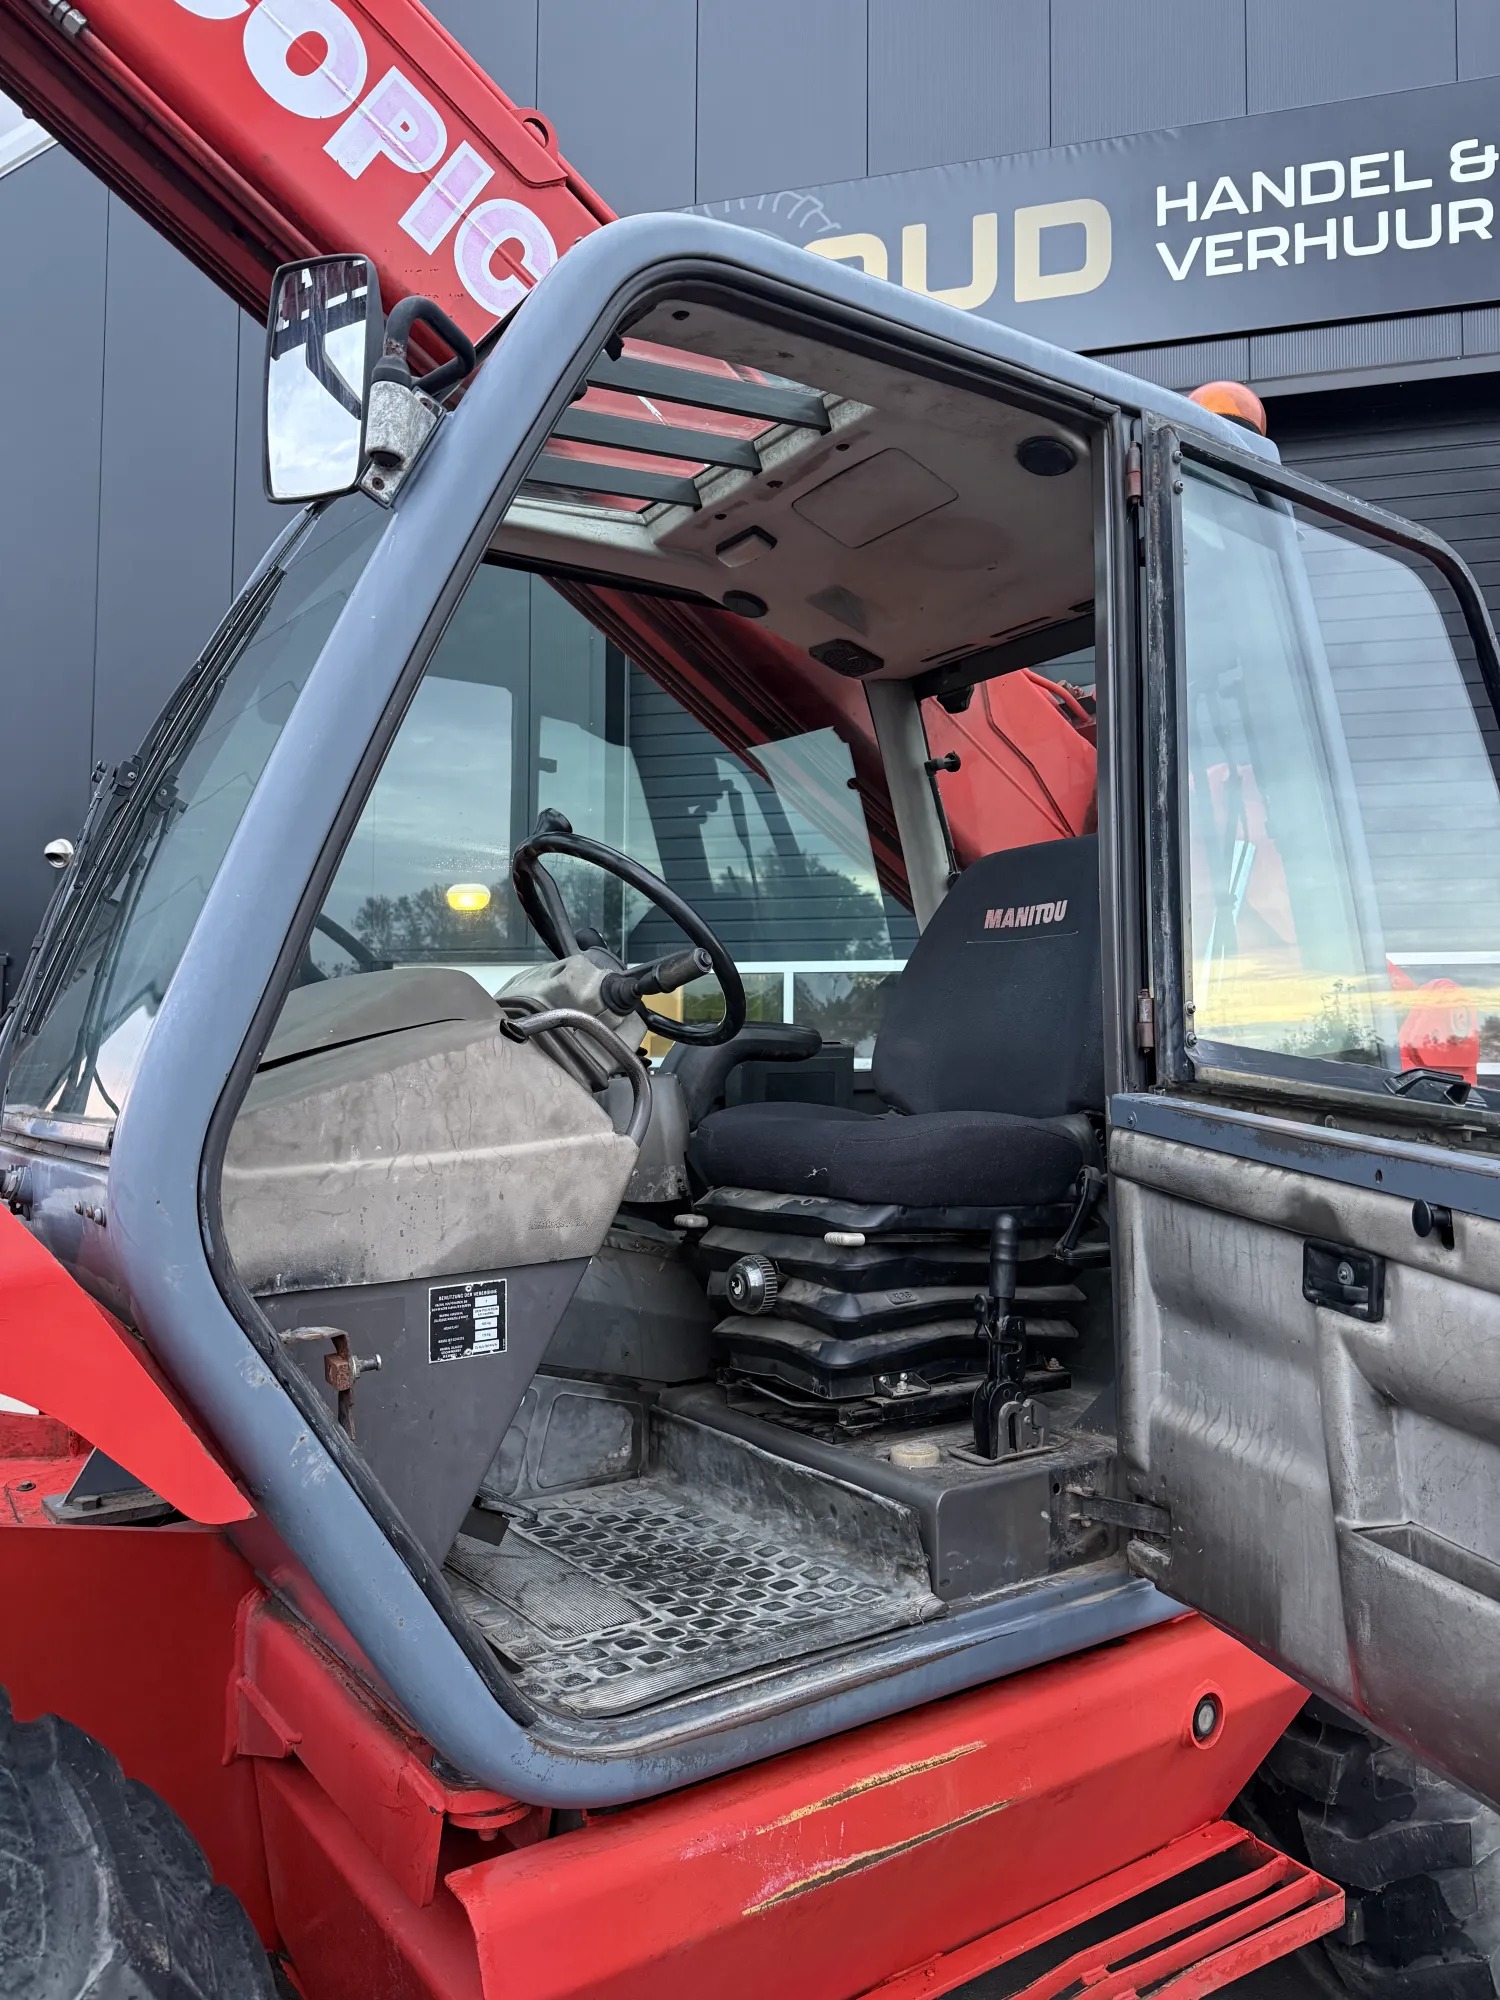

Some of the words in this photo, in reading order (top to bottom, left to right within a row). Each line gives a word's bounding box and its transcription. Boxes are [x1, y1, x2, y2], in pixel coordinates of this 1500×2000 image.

[1156, 149, 1433, 227] HANDEL
[1449, 138, 1500, 183] &
[1155, 197, 1494, 281] VERHUUR
[983, 899, 1068, 930] MANITOU
